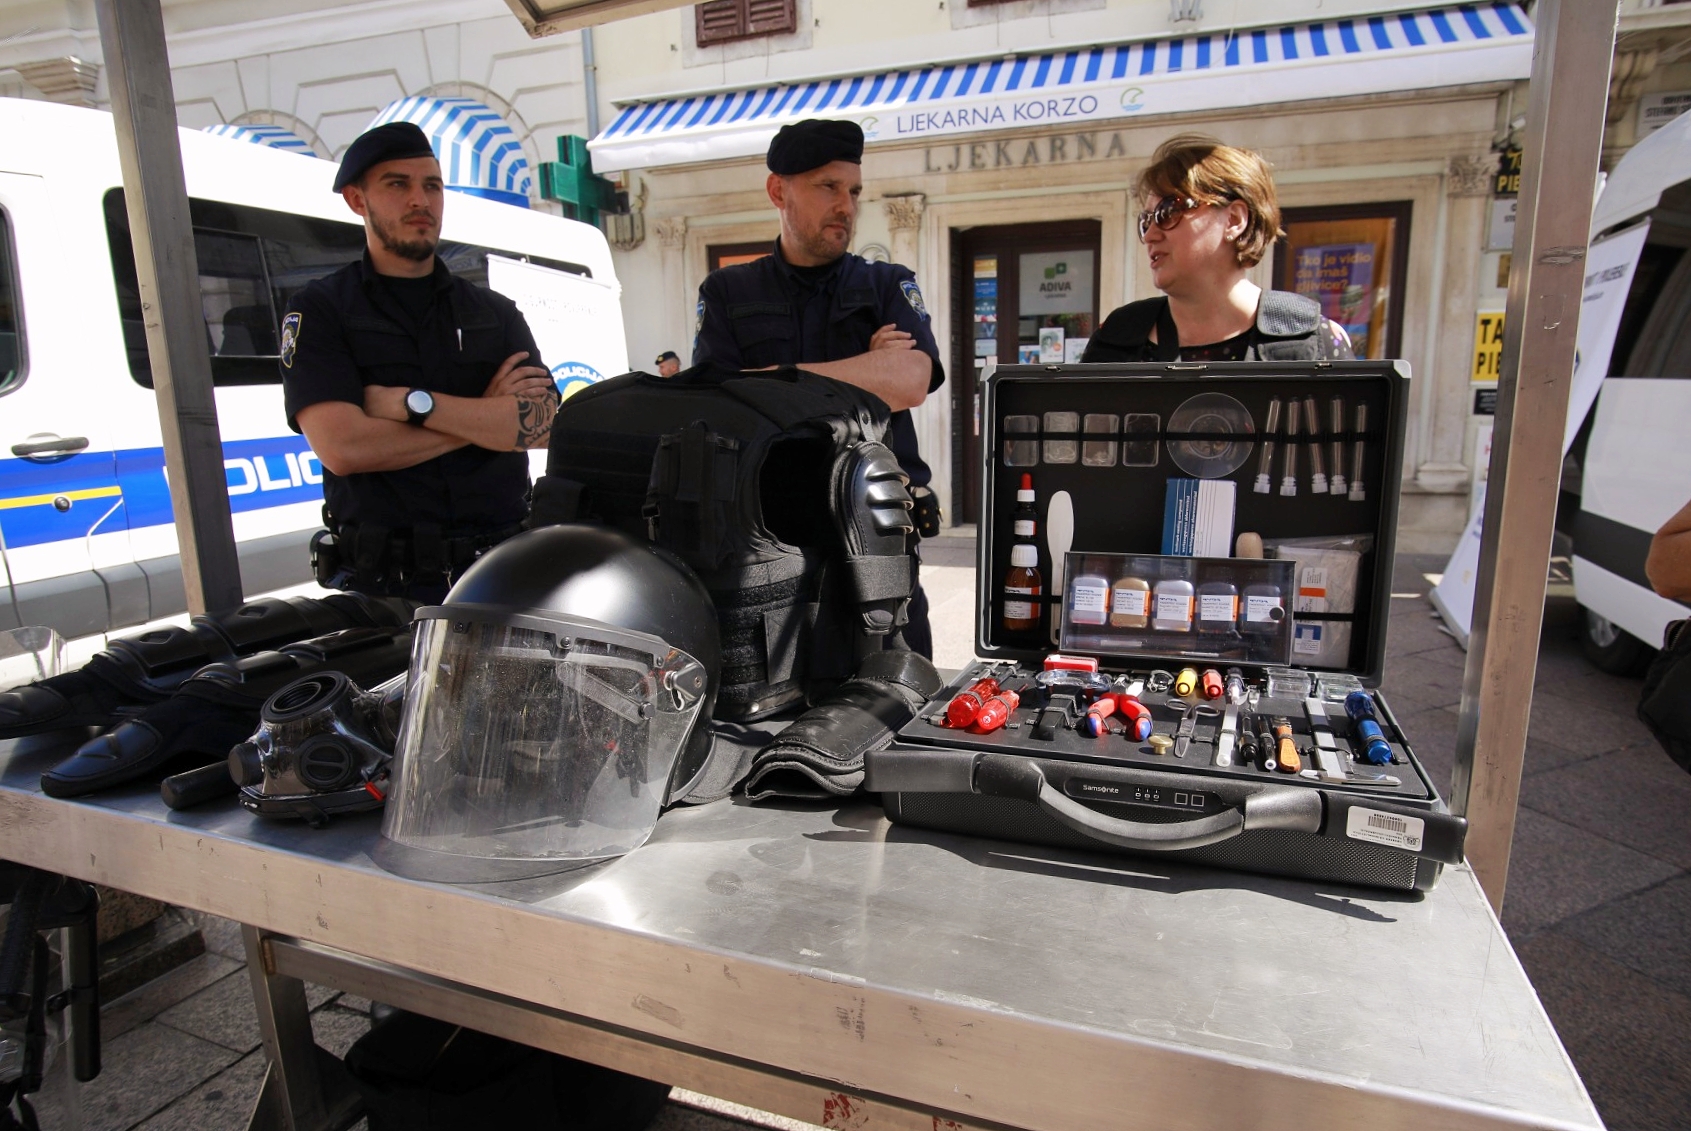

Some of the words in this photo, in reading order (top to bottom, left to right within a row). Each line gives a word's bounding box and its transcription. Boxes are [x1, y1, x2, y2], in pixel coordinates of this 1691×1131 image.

[897, 105, 1005, 133] LJEKARNA
[1013, 95, 1098, 121] KORZO
[924, 131, 1126, 173] LJEKARNA
[1297, 255, 1321, 266] Tko
[1323, 253, 1337, 267] je
[1339, 252, 1372, 264] vidio
[1297, 269, 1313, 279] da
[1038, 281, 1072, 293] ADIVA
[1082, 784, 1119, 794] Samsonite
